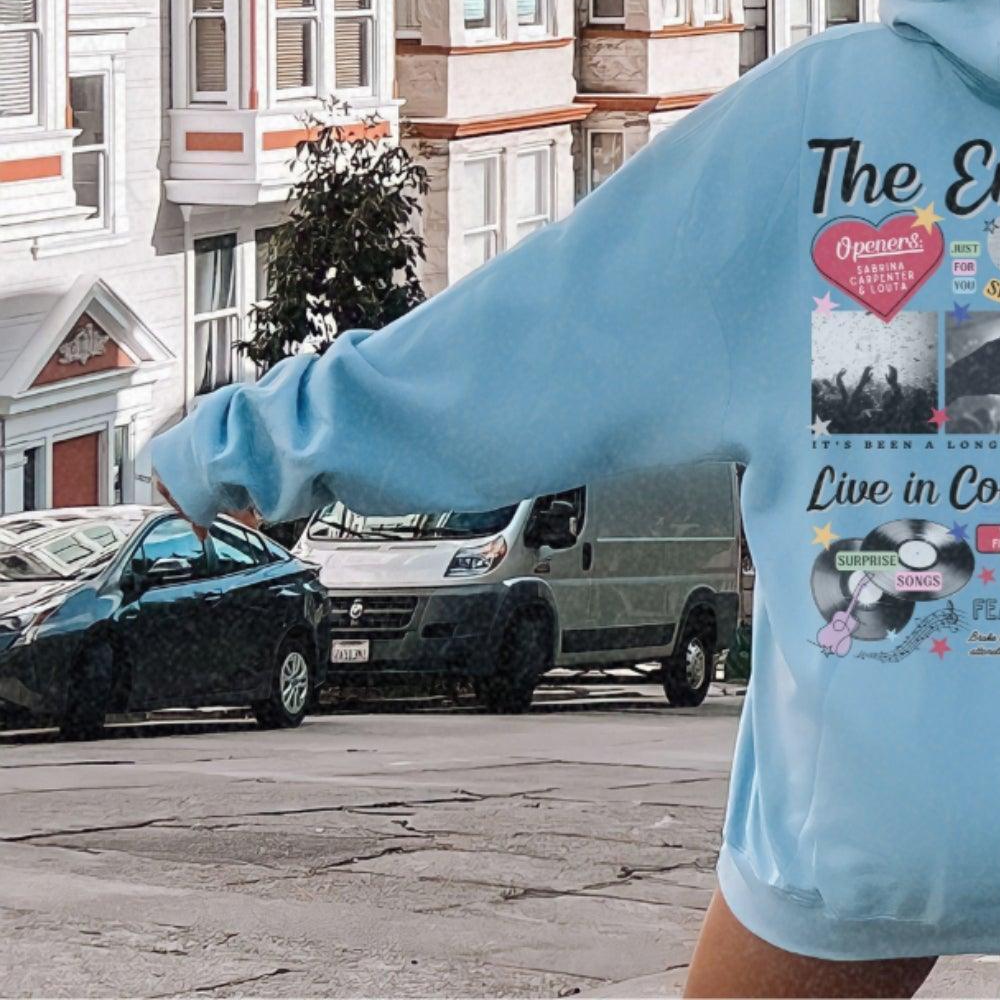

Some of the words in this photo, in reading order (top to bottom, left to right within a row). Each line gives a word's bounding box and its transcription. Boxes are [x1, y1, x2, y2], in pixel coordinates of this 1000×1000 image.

[807, 137, 925, 215] The
[836, 233, 924, 262] Openers:
[951, 244, 978, 253] JUST
[856, 262, 905, 275] SABRINA
[954, 262, 975, 272] FOR
[849, 270, 915, 286] CARPENTER
[954, 280, 975, 290] YOU
[811, 440, 852, 450] IT'S
[864, 440, 913, 450] BEEN
[924, 440, 934, 450] A
[947, 440, 997, 450] LONG
[806, 464, 893, 512] Live
[903, 471, 940, 506] in
[837, 555, 897, 567] SURPRISE
[896, 574, 941, 587] SONGS
